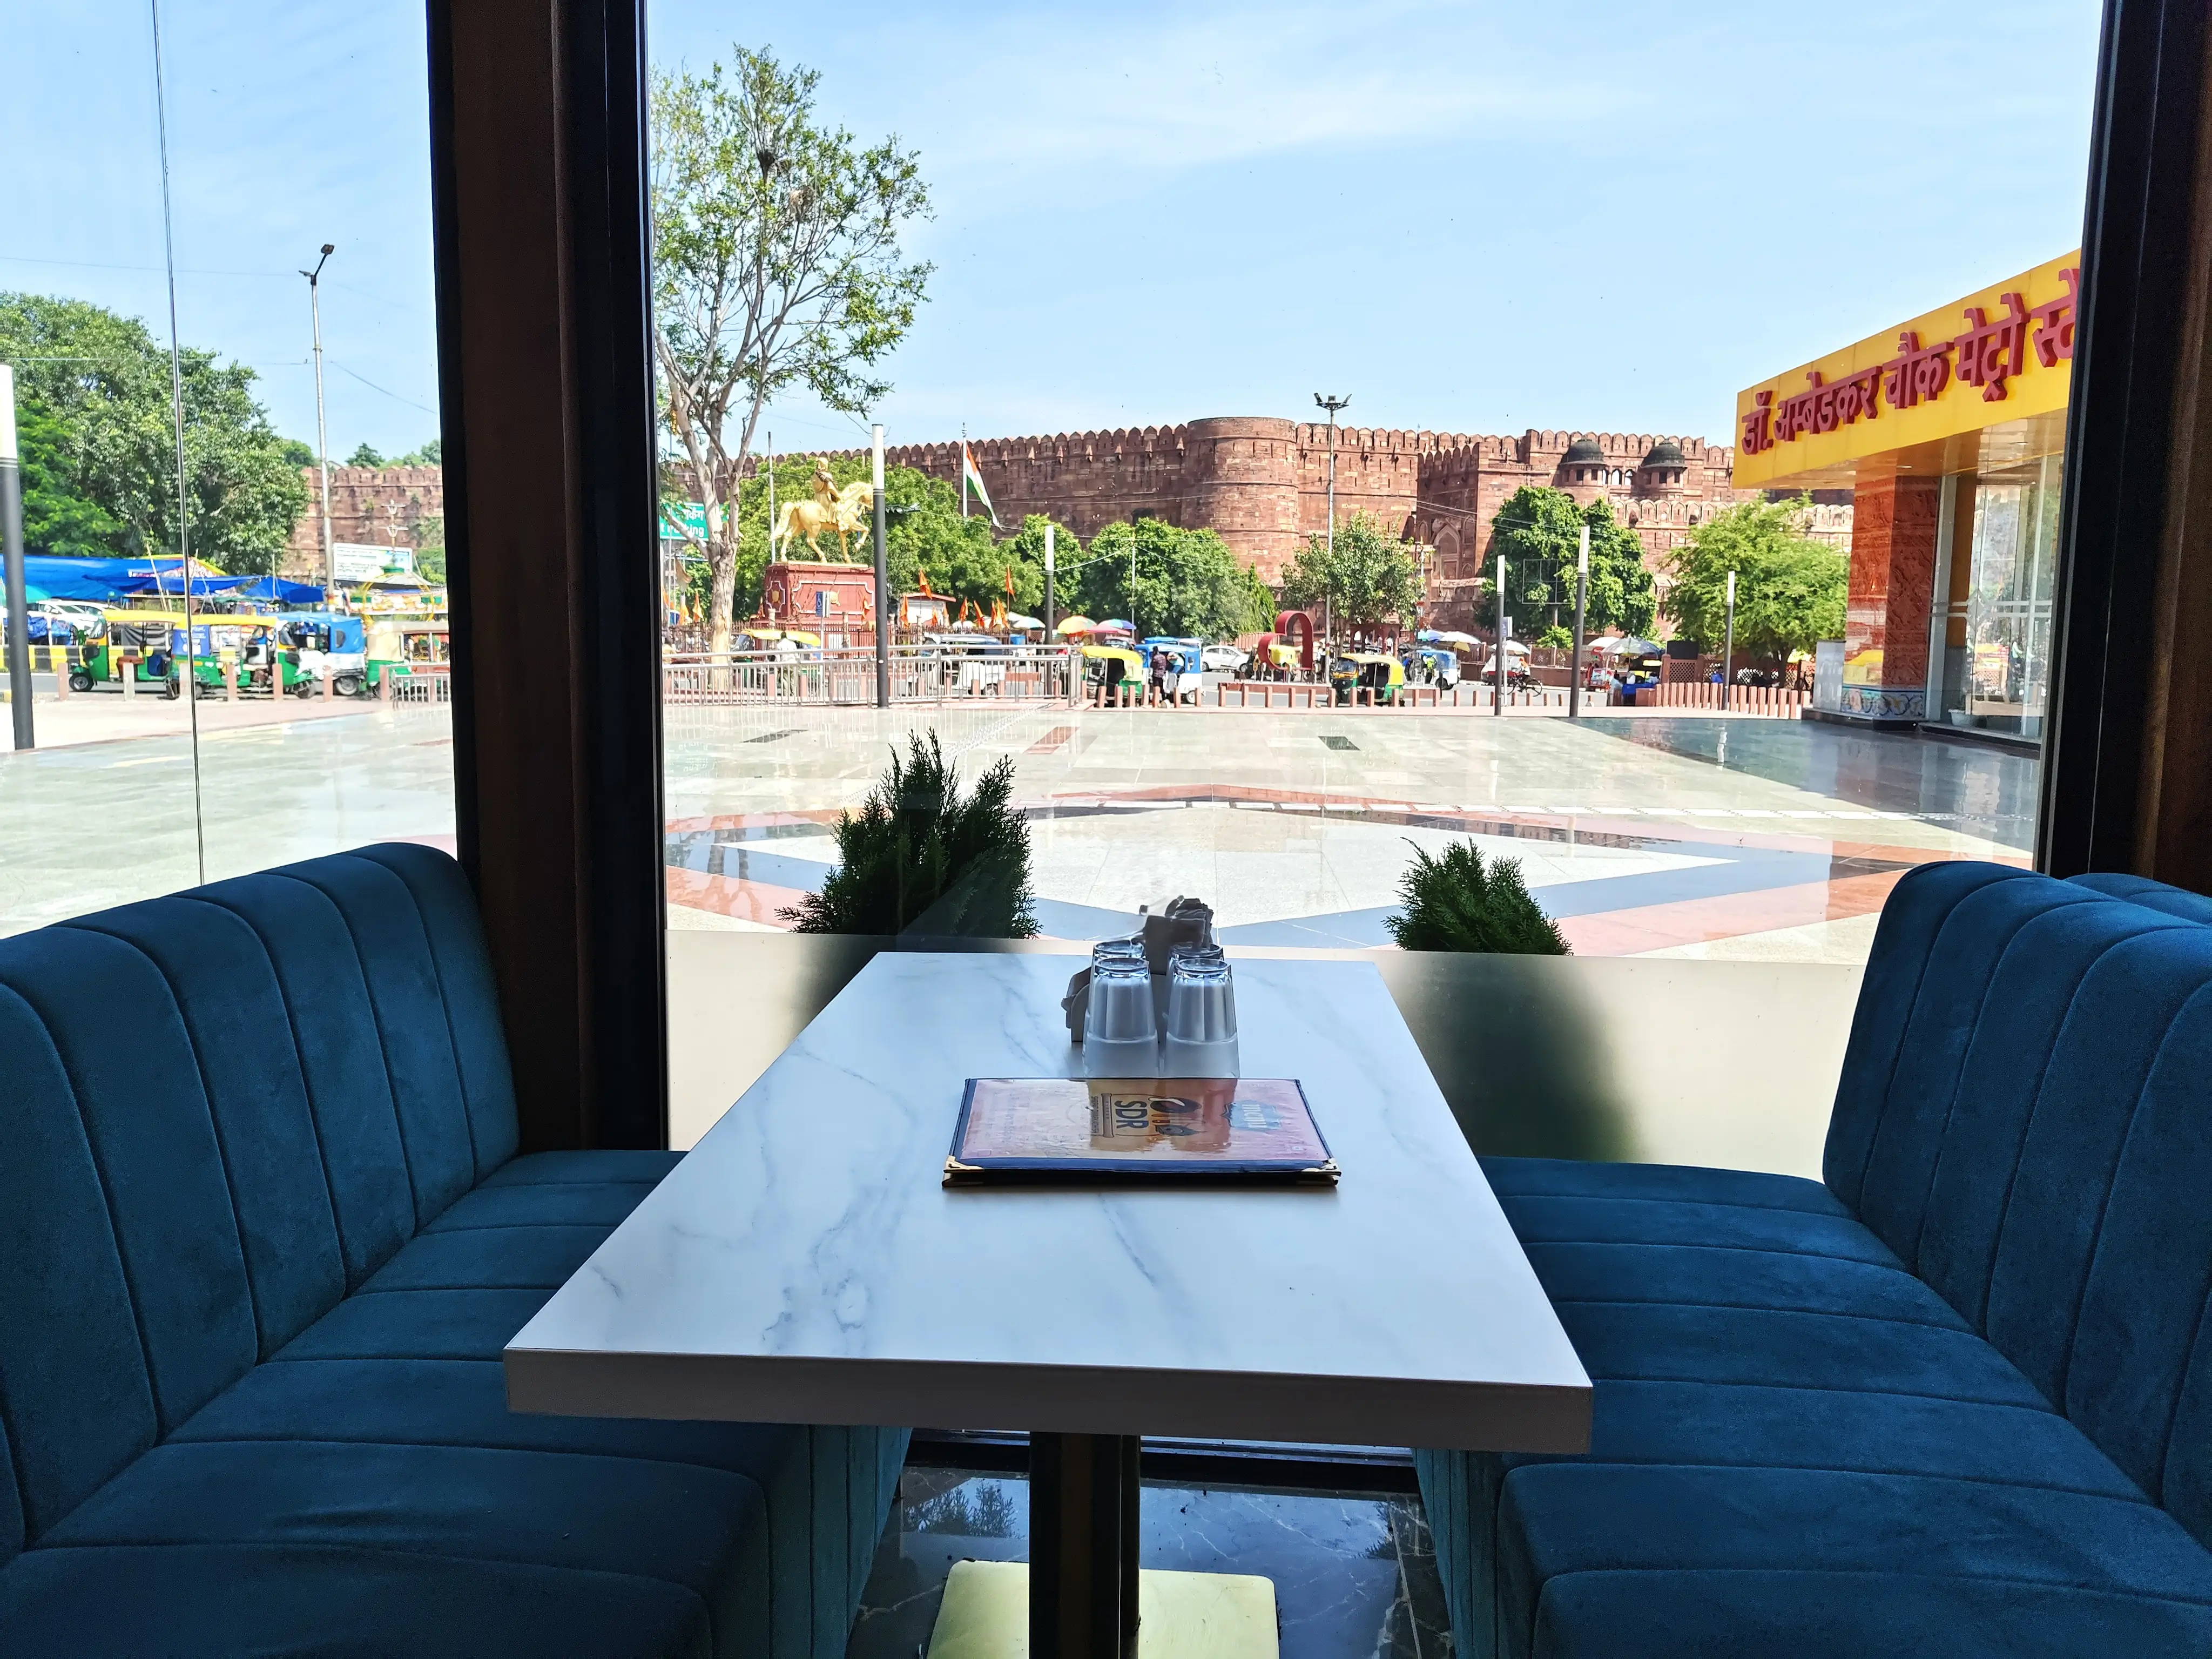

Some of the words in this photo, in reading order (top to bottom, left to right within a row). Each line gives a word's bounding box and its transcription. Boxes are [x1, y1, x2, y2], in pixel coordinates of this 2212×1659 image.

[1742, 390, 1773, 455] डॉ.
[1773, 372, 1883, 441] अम्बेडकर
[1883, 332, 1955, 409] चौक
[1954, 293, 2031, 402] मेट्रो
[1114, 1100, 1149, 1129] SDR
